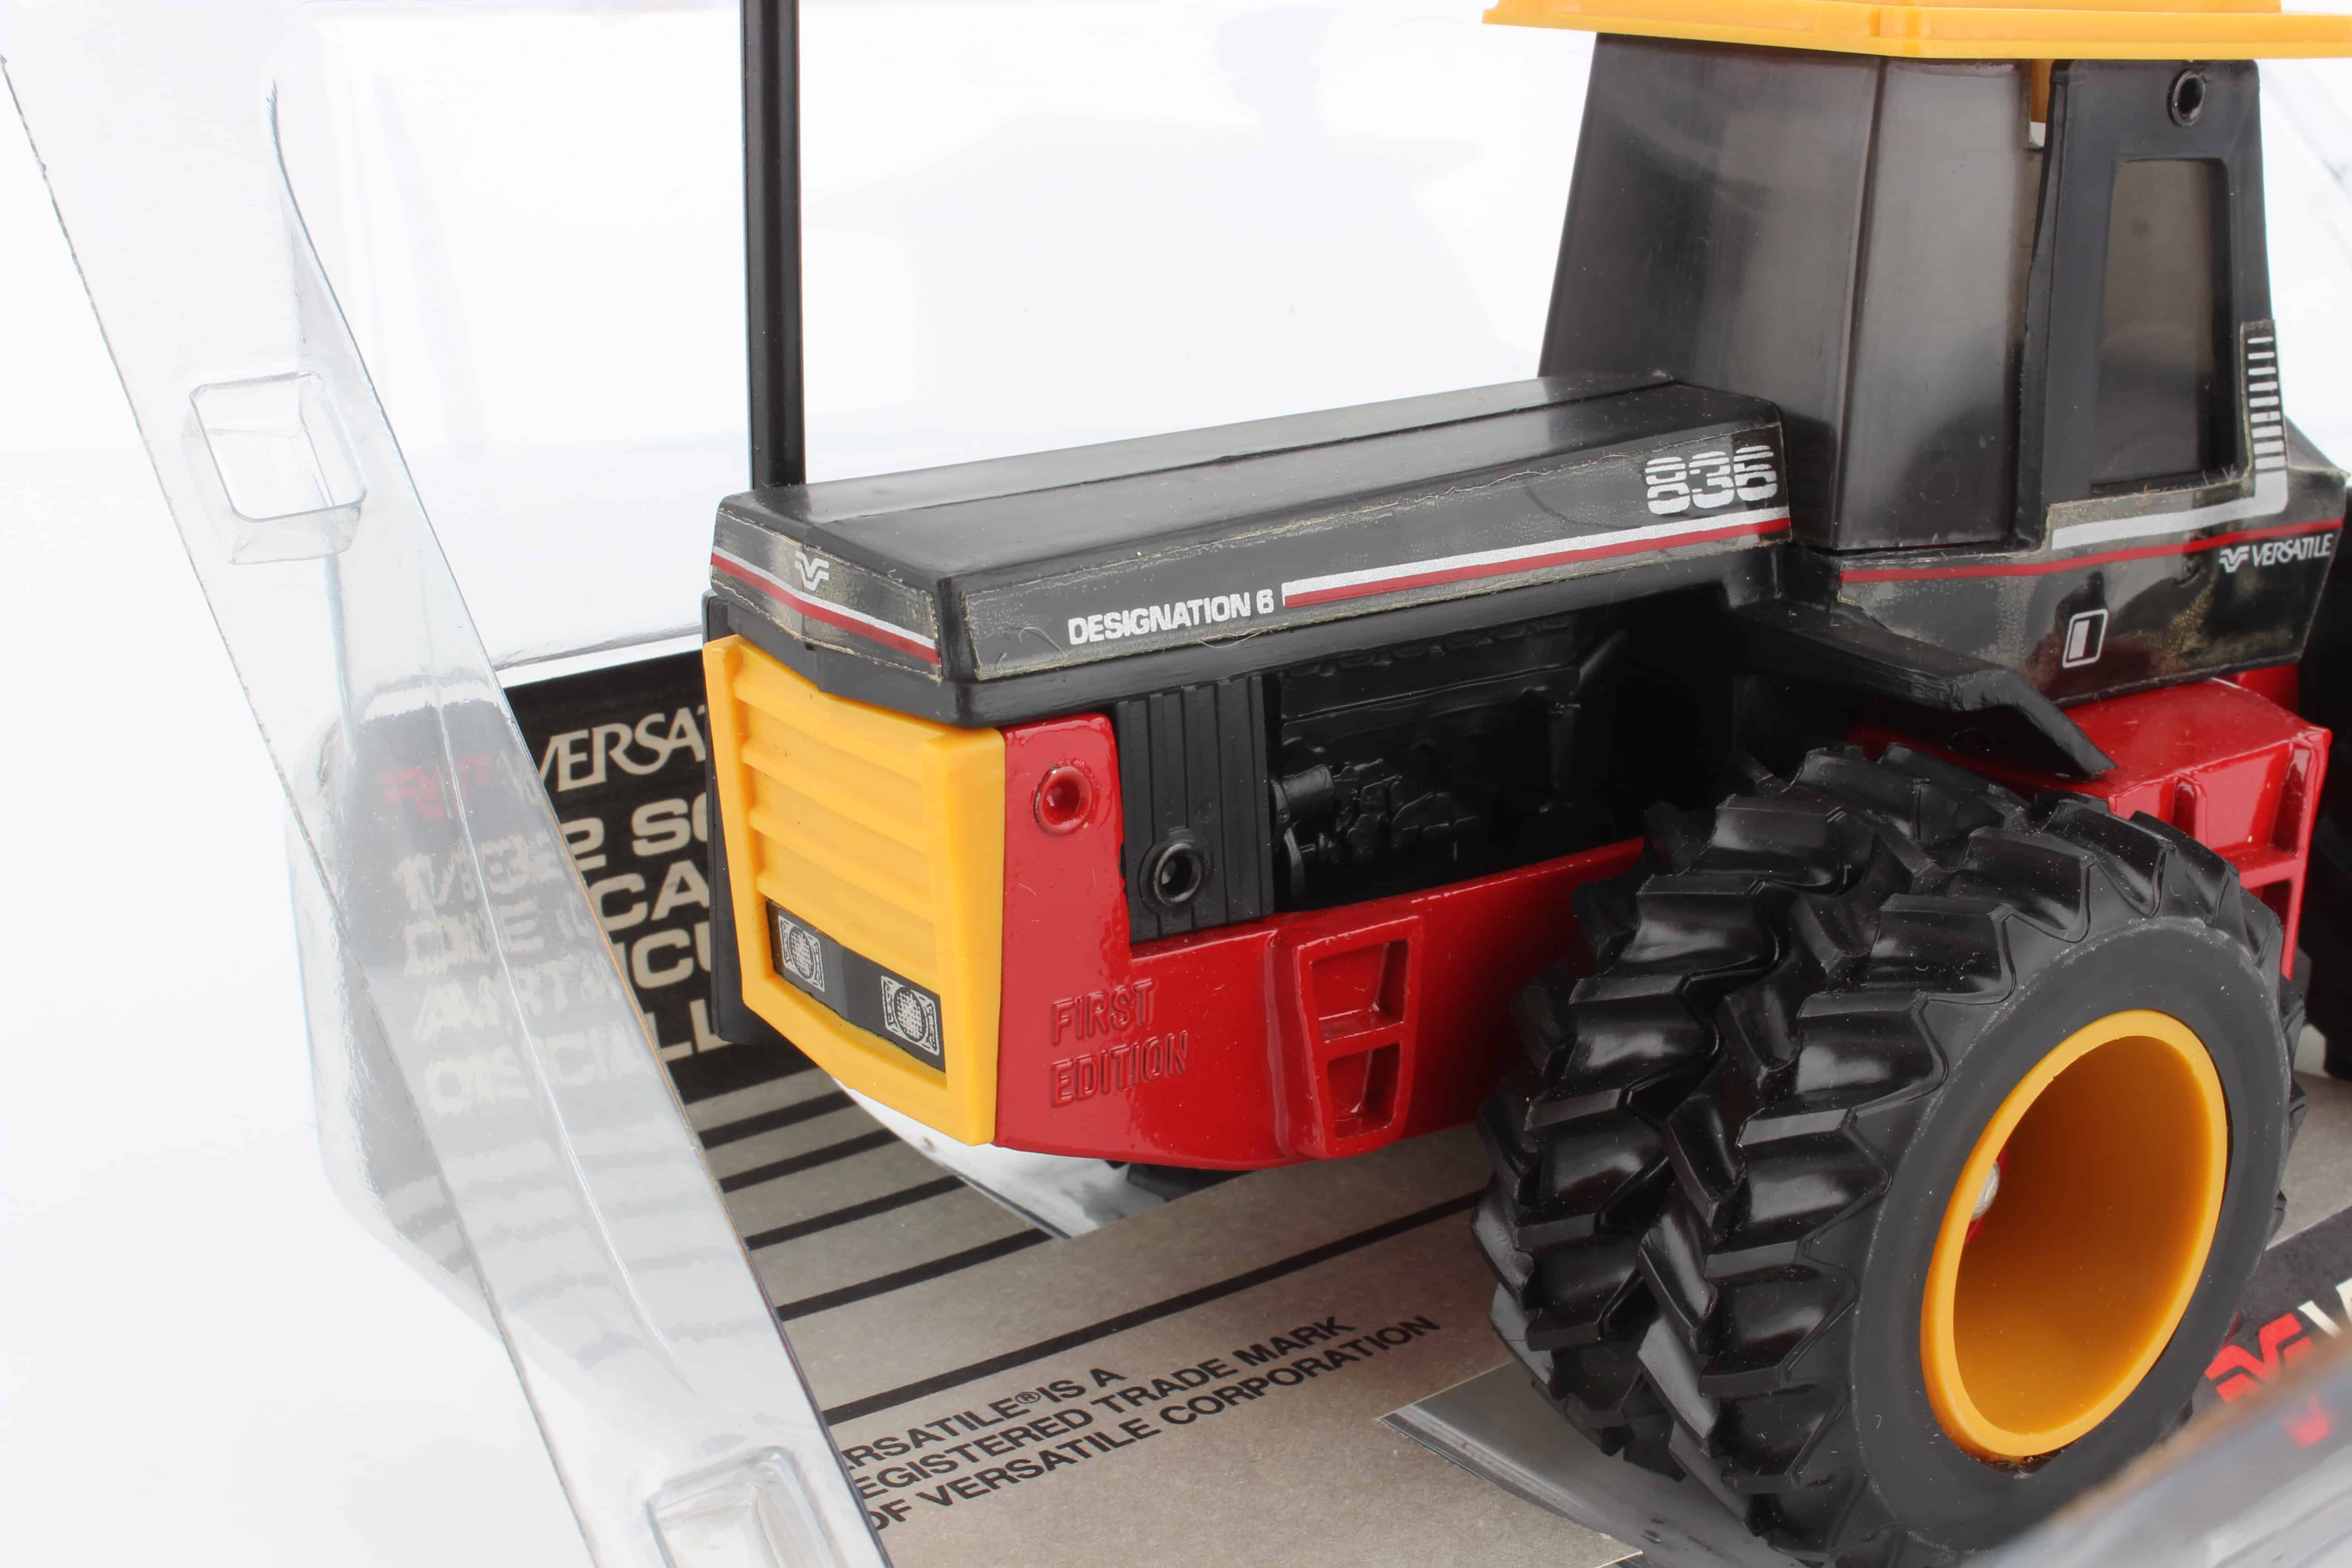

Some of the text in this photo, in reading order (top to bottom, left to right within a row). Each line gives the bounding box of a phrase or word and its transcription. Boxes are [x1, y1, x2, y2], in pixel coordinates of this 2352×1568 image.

[1644, 445, 1778, 514] 836
[2252, 533, 2333, 567] VERSATILE
[1068, 588, 1274, 645] DESIGNATION 6
[538, 704, 706, 792] ERSA
[632, 792, 707, 857] S
[1051, 978, 1155, 1046] FIRST
[1050, 1030, 1188, 1107] EDITION
[842, 1367, 1128, 1470] RSATILE® IS A
[854, 1315, 1357, 1499] EGISTERED TRADE MARK
[915, 1417, 1161, 1507] VERSATILE
[1159, 1316, 1441, 1425] CORPORATION
